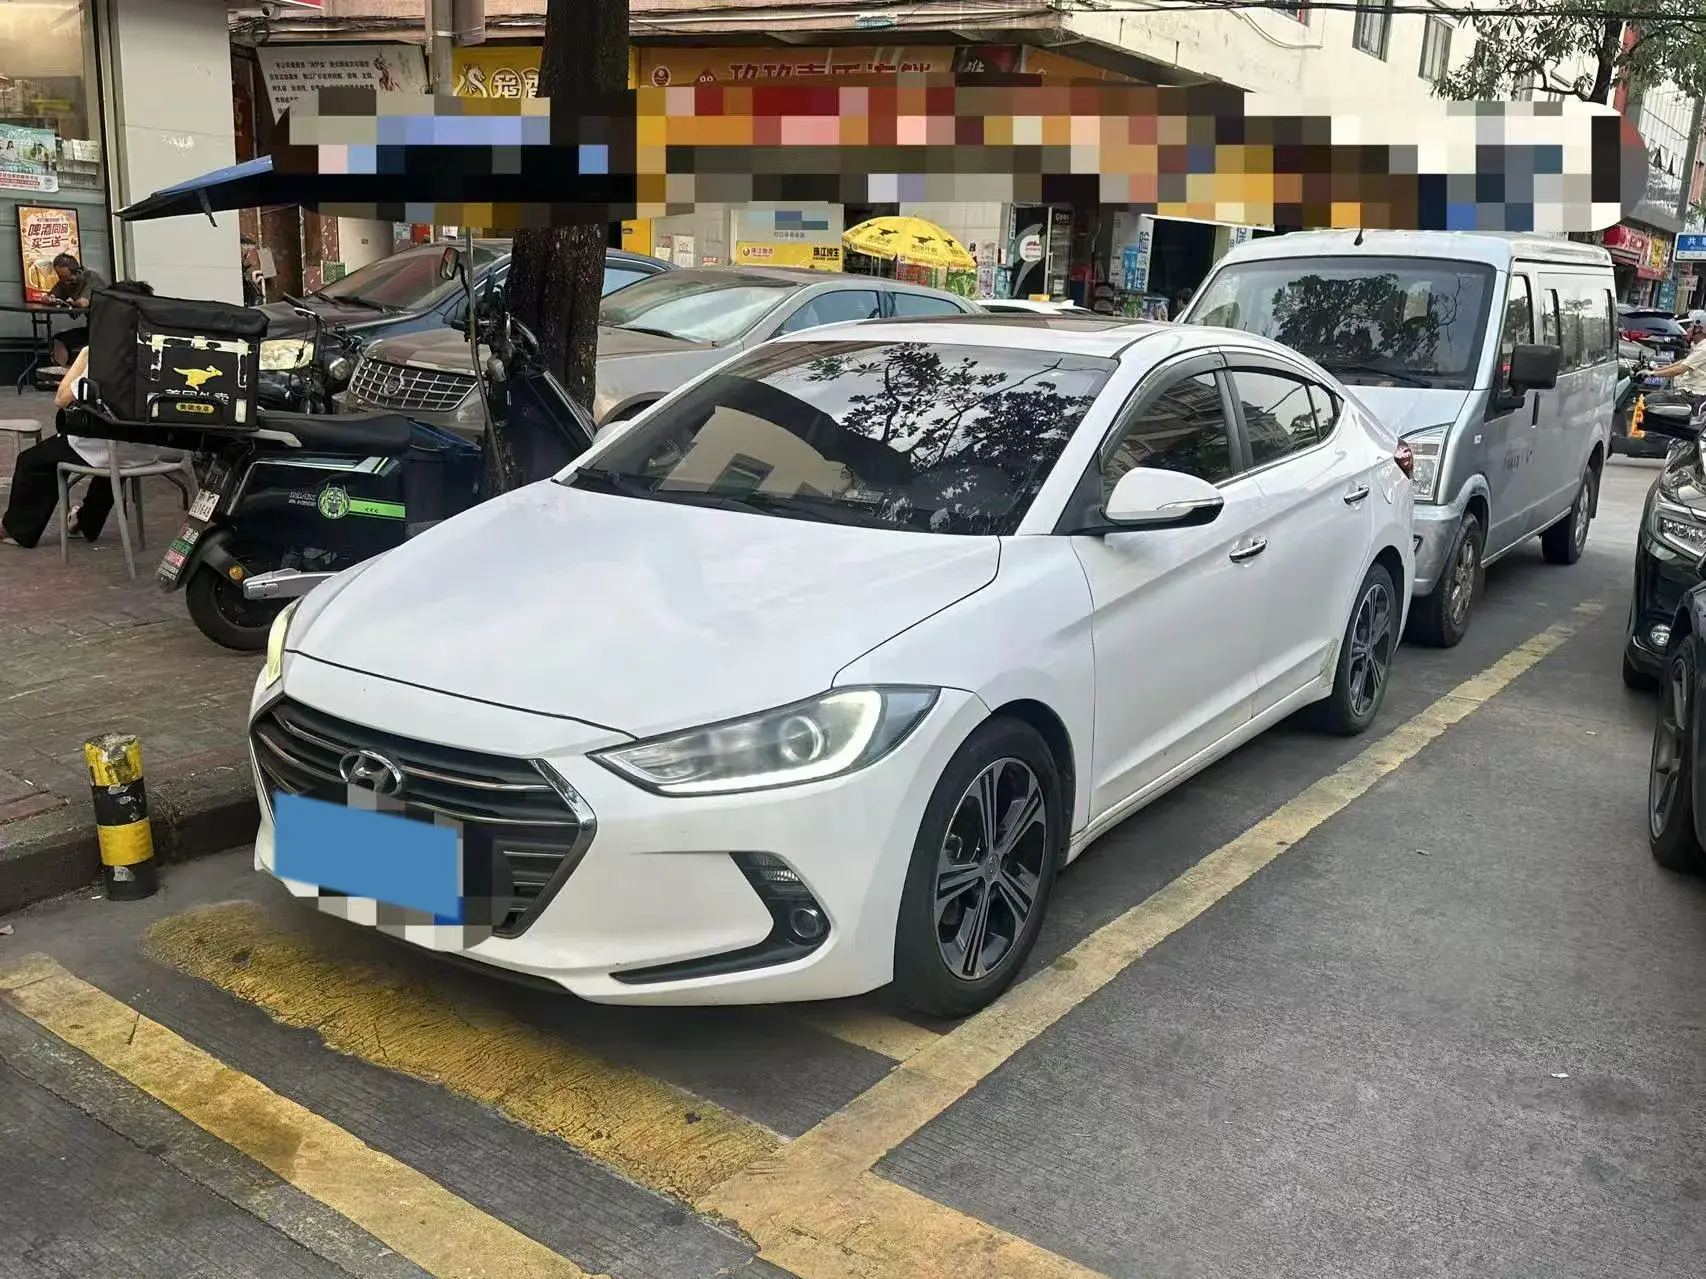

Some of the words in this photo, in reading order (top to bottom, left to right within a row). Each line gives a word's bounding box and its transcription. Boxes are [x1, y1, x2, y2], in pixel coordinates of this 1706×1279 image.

[28, 223, 69, 236] 啤酒同品
[31, 236, 69, 250] 买三送一
